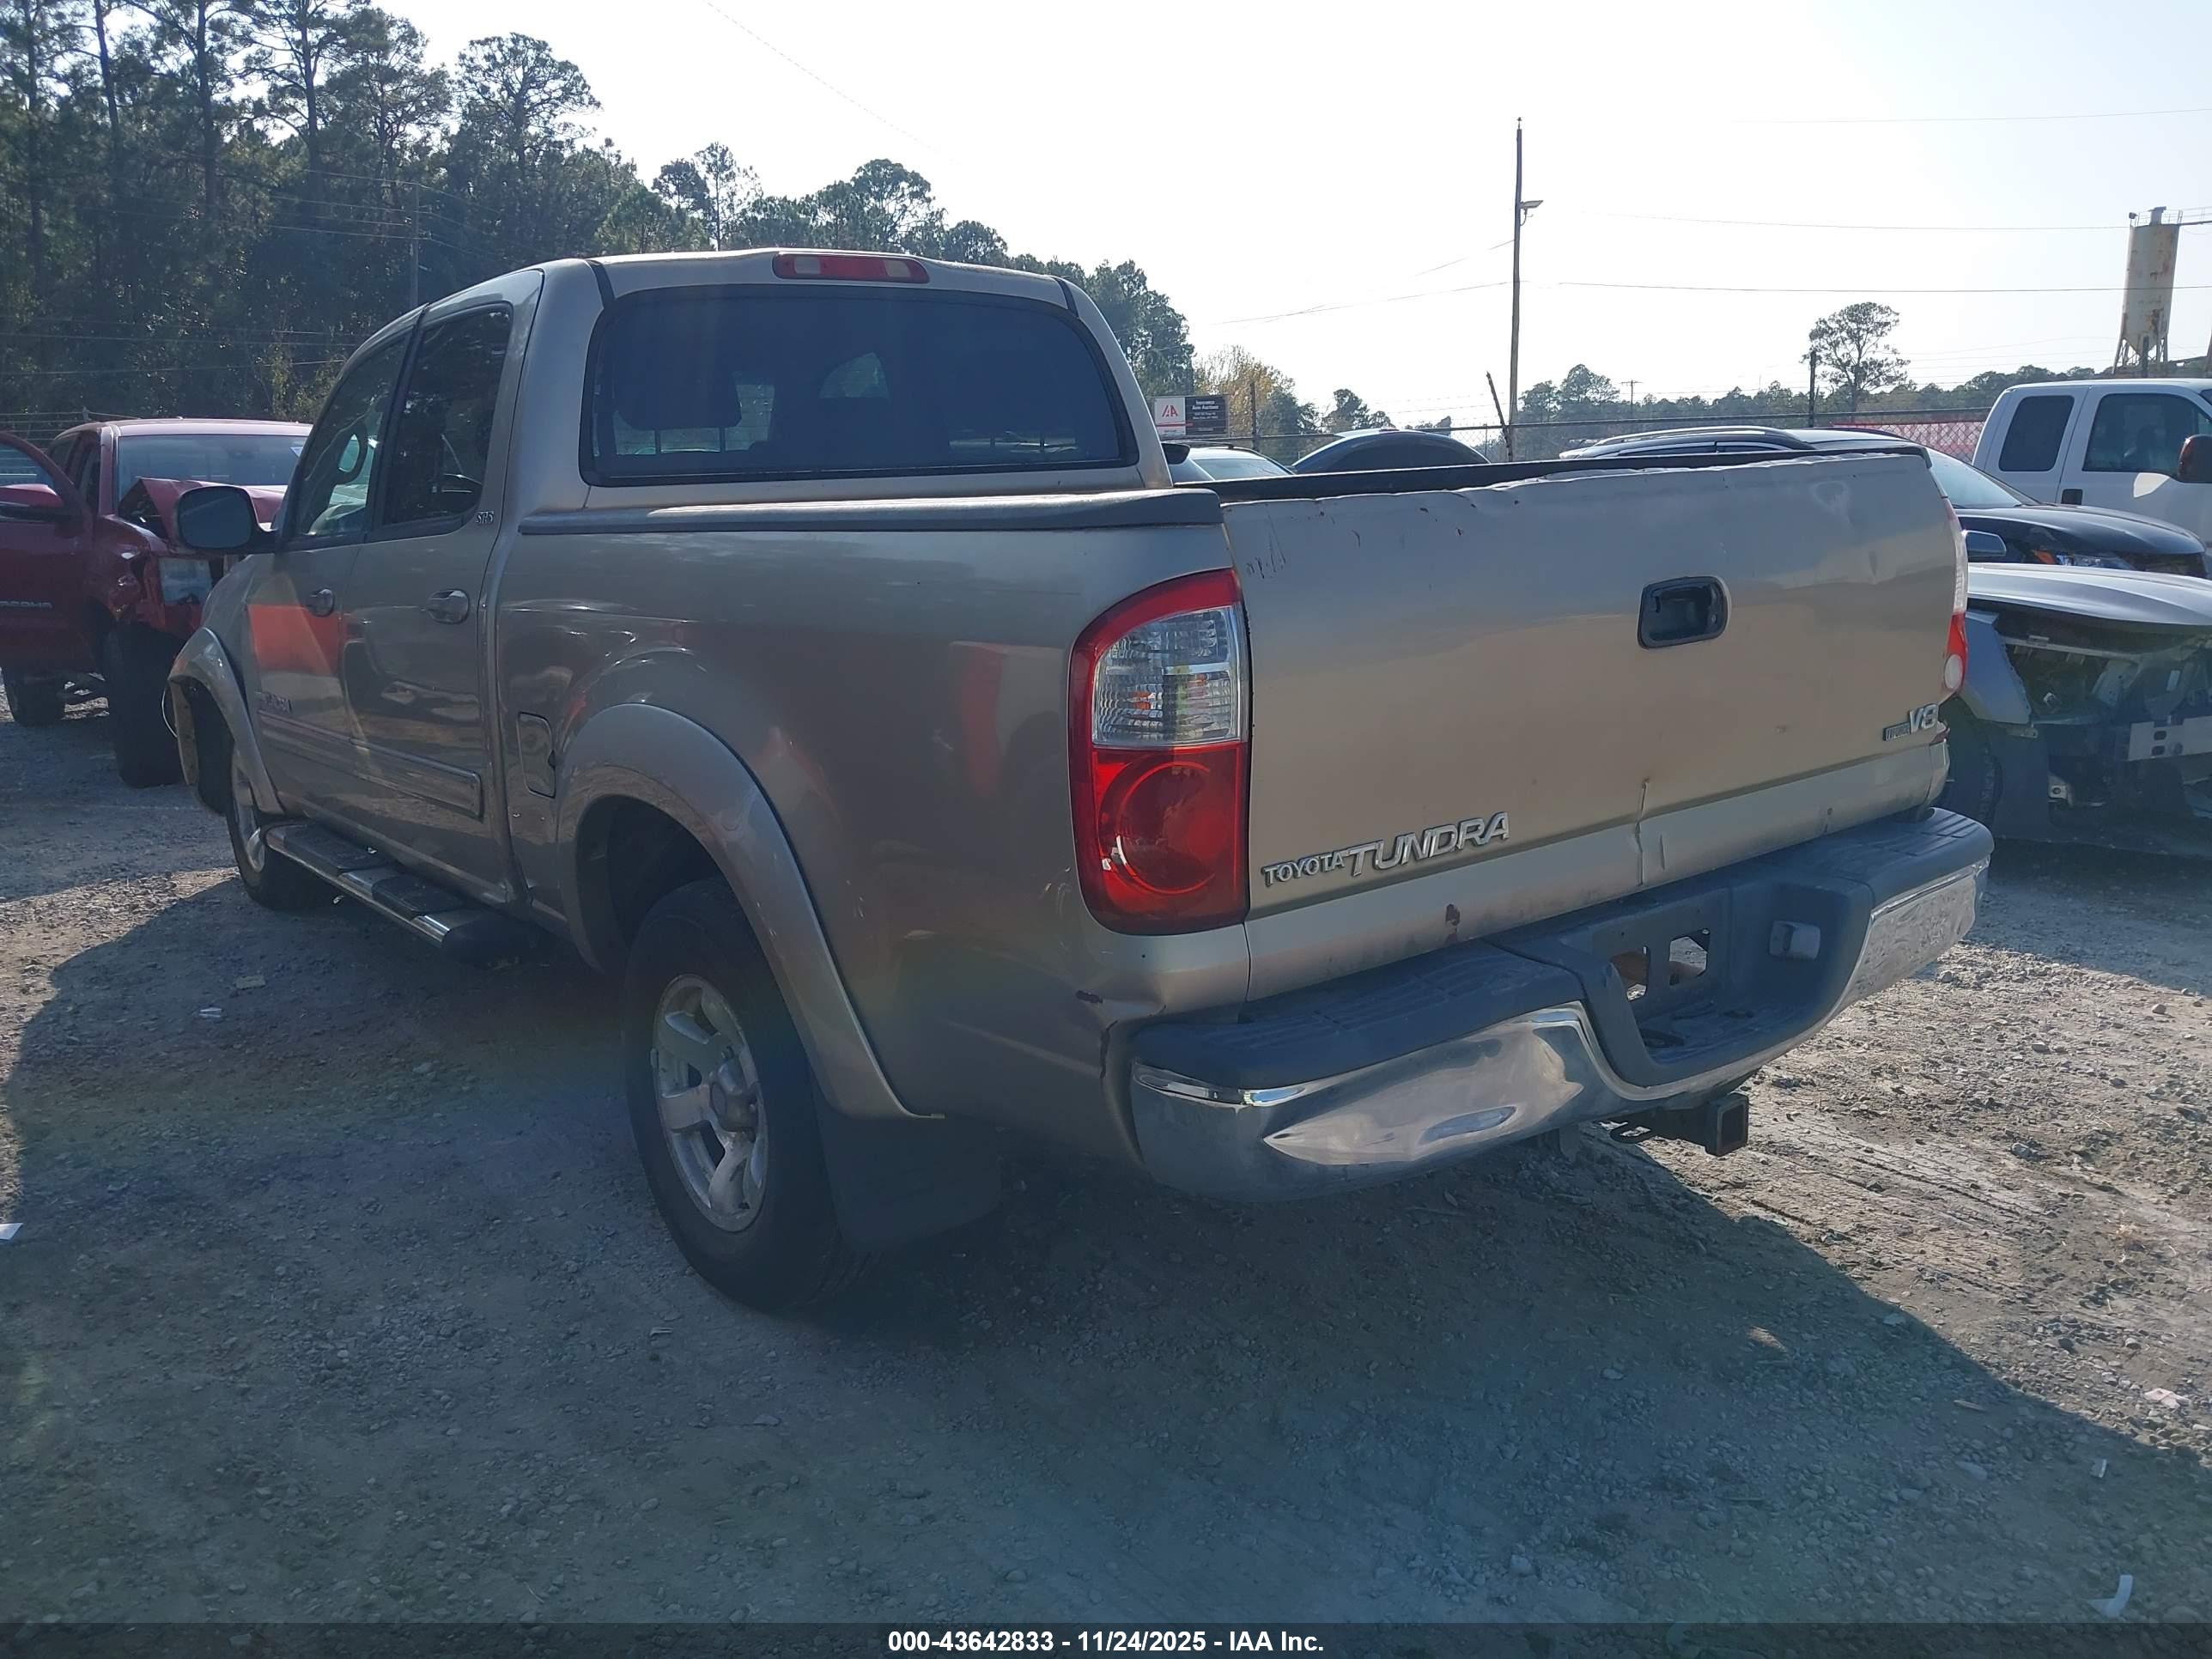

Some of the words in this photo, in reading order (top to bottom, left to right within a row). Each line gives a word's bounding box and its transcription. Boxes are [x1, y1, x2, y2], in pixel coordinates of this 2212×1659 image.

[1909, 703, 1938, 733] V8
[1262, 852, 1346, 886] TOYOTA
[1346, 811, 1510, 877] TUNDRA
